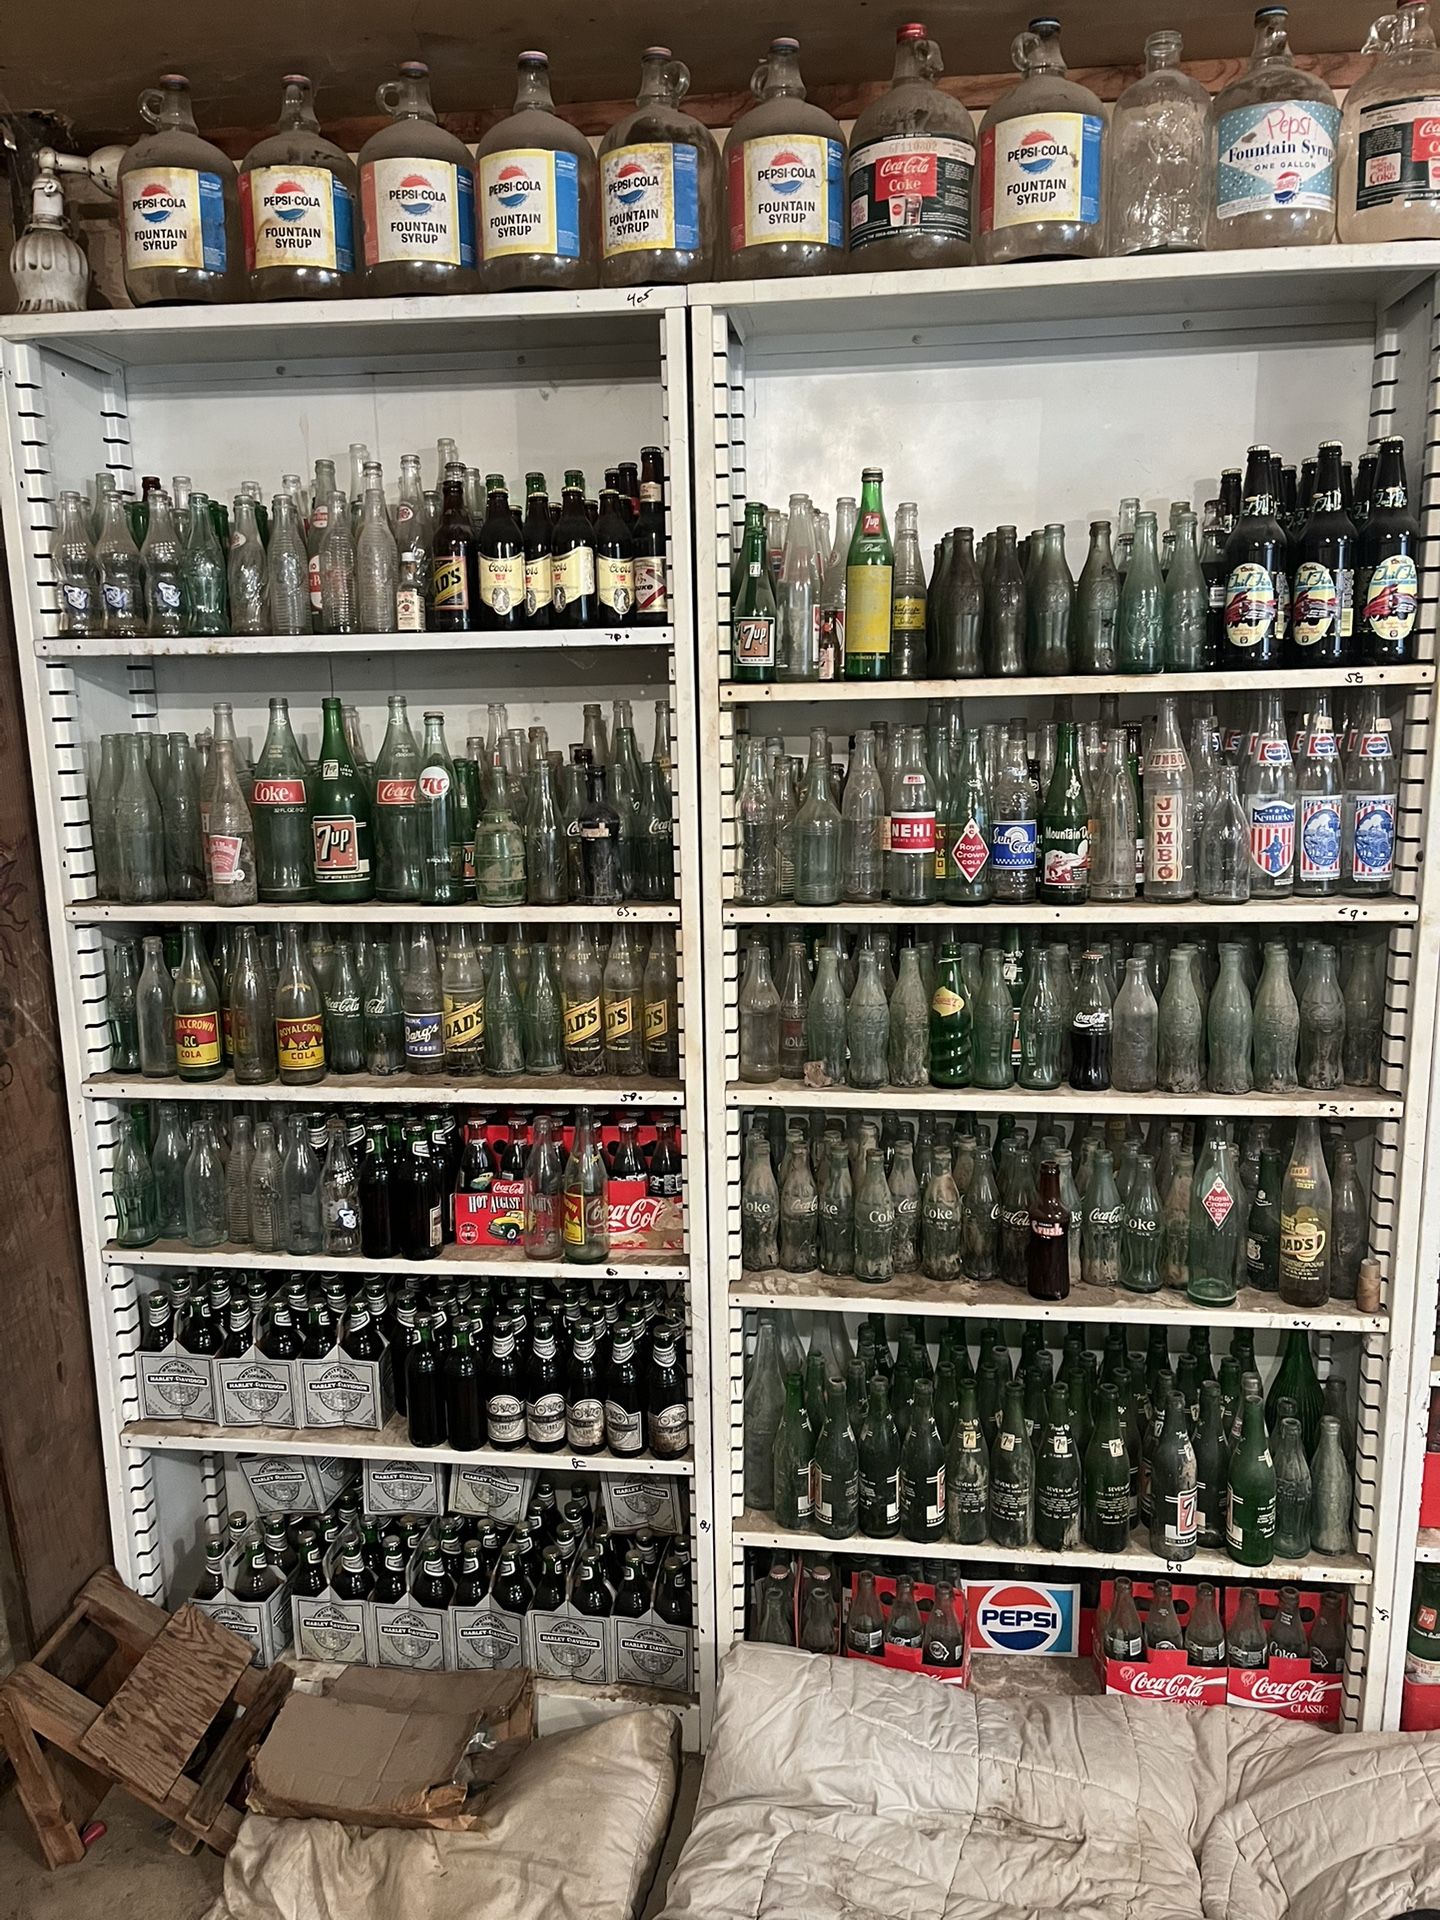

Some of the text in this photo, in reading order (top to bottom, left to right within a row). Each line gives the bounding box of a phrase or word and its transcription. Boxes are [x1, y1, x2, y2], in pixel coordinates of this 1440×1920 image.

[1263, 108, 1311, 141] Pepsi
[1229, 139, 1334, 163] Fountain Syrup
[1254, 161, 1316, 171] ONE GALLON
[1369, 171, 1397, 184] Coke
[889, 179, 921, 192] Coke
[1006, 179, 1067, 196] FOUNTAIN
[1016, 191, 1057, 206] SYRUP
[758, 201, 816, 214] FOUNTAIN
[489, 213, 542, 228] FOUNTAIN
[609, 208, 659, 227] FOUNTAIN
[768, 212, 807, 225] SYRUP
[134, 228, 187, 240] FOUNTAIN
[265, 227, 321, 239] FOUNTAIN
[390, 221, 447, 234] FOUNTAIN
[497, 225, 532, 238] SYRUP
[616, 221, 650, 237] SYRUP
[142, 239, 178, 250] SYRUP
[274, 237, 312, 249] SYRUP
[400, 232, 439, 244] SYRUP
[488, 562, 513, 573] Coors
[1150, 752, 1185, 766] JUMBO
[254, 781, 290, 802] Coke
[421, 777, 448, 795] RC
[892, 823, 931, 838] NEHI
[993, 827, 1011, 845] Sun
[1045, 826, 1080, 840] Mountain
[316, 824, 350, 862] 7up
[1156, 797, 1173, 880] JUMBO
[959, 843, 984, 851] Royal
[956, 851, 986, 859] Crown
[187, 1019, 215, 1032] CROWN
[567, 1006, 598, 1035] AD'S
[279, 1025, 301, 1037] ROYAL
[405, 1023, 439, 1043] Barq's
[183, 1035, 197, 1047] RC
[298, 1040, 309, 1050] RC
[181, 1050, 202, 1058] COLA
[291, 1052, 316, 1060] COLA
[468, 1195, 488, 1213] HOT
[490, 1195, 521, 1213] AUGUST
[1281, 1238, 1314, 1251] DAD'S
[982, 1609, 1058, 1629] PEPSI
[1130, 1671, 1205, 1698] Coca-Cola
[1251, 1676, 1328, 1704] Coca-Cola
[1290, 1704, 1329, 1714] CLASSIC
